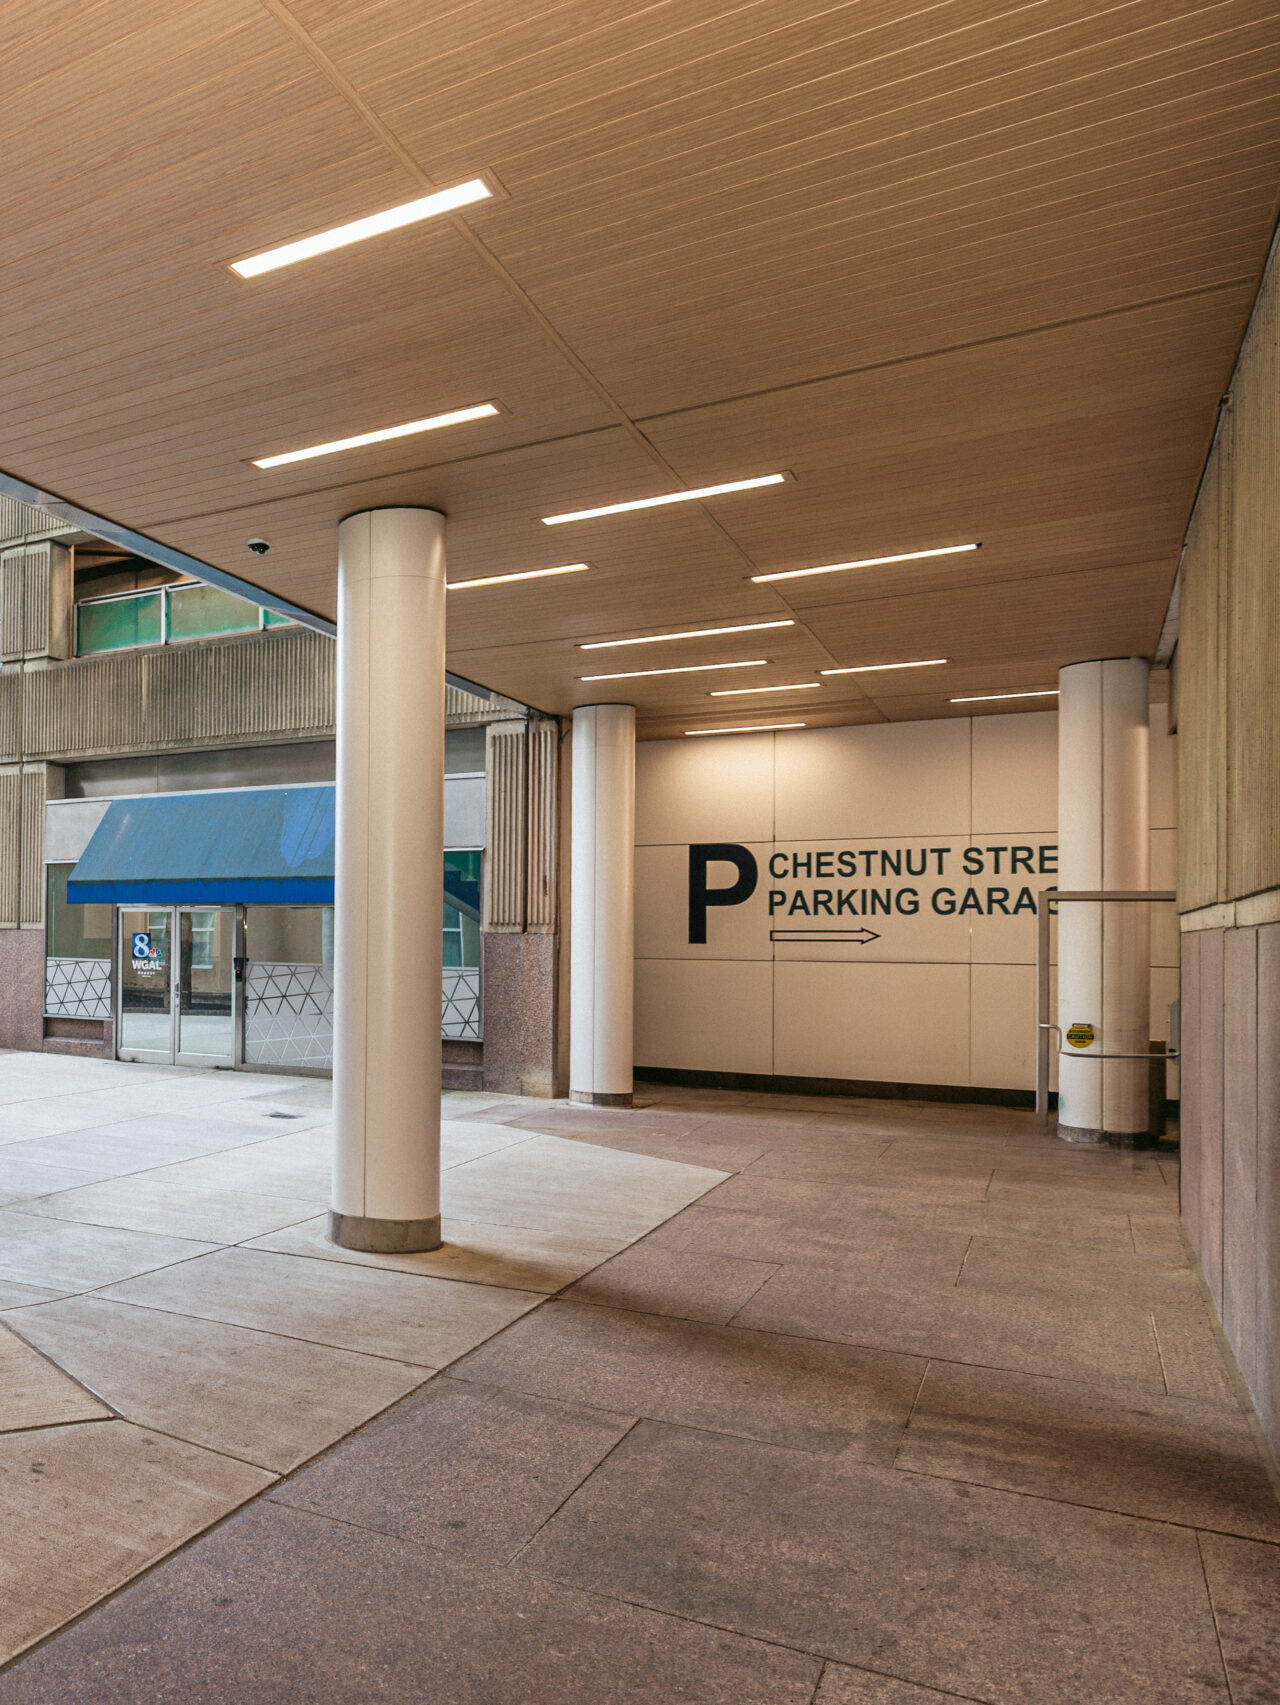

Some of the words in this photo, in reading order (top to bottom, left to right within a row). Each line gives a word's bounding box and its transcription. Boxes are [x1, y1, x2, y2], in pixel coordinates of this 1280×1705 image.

[769, 848, 951, 879] CHESTNUT
[689, 843, 758, 944] P
[769, 888, 920, 916] PARKING
[134, 934, 149, 957] 8
[132, 960, 162, 970] WGAL
